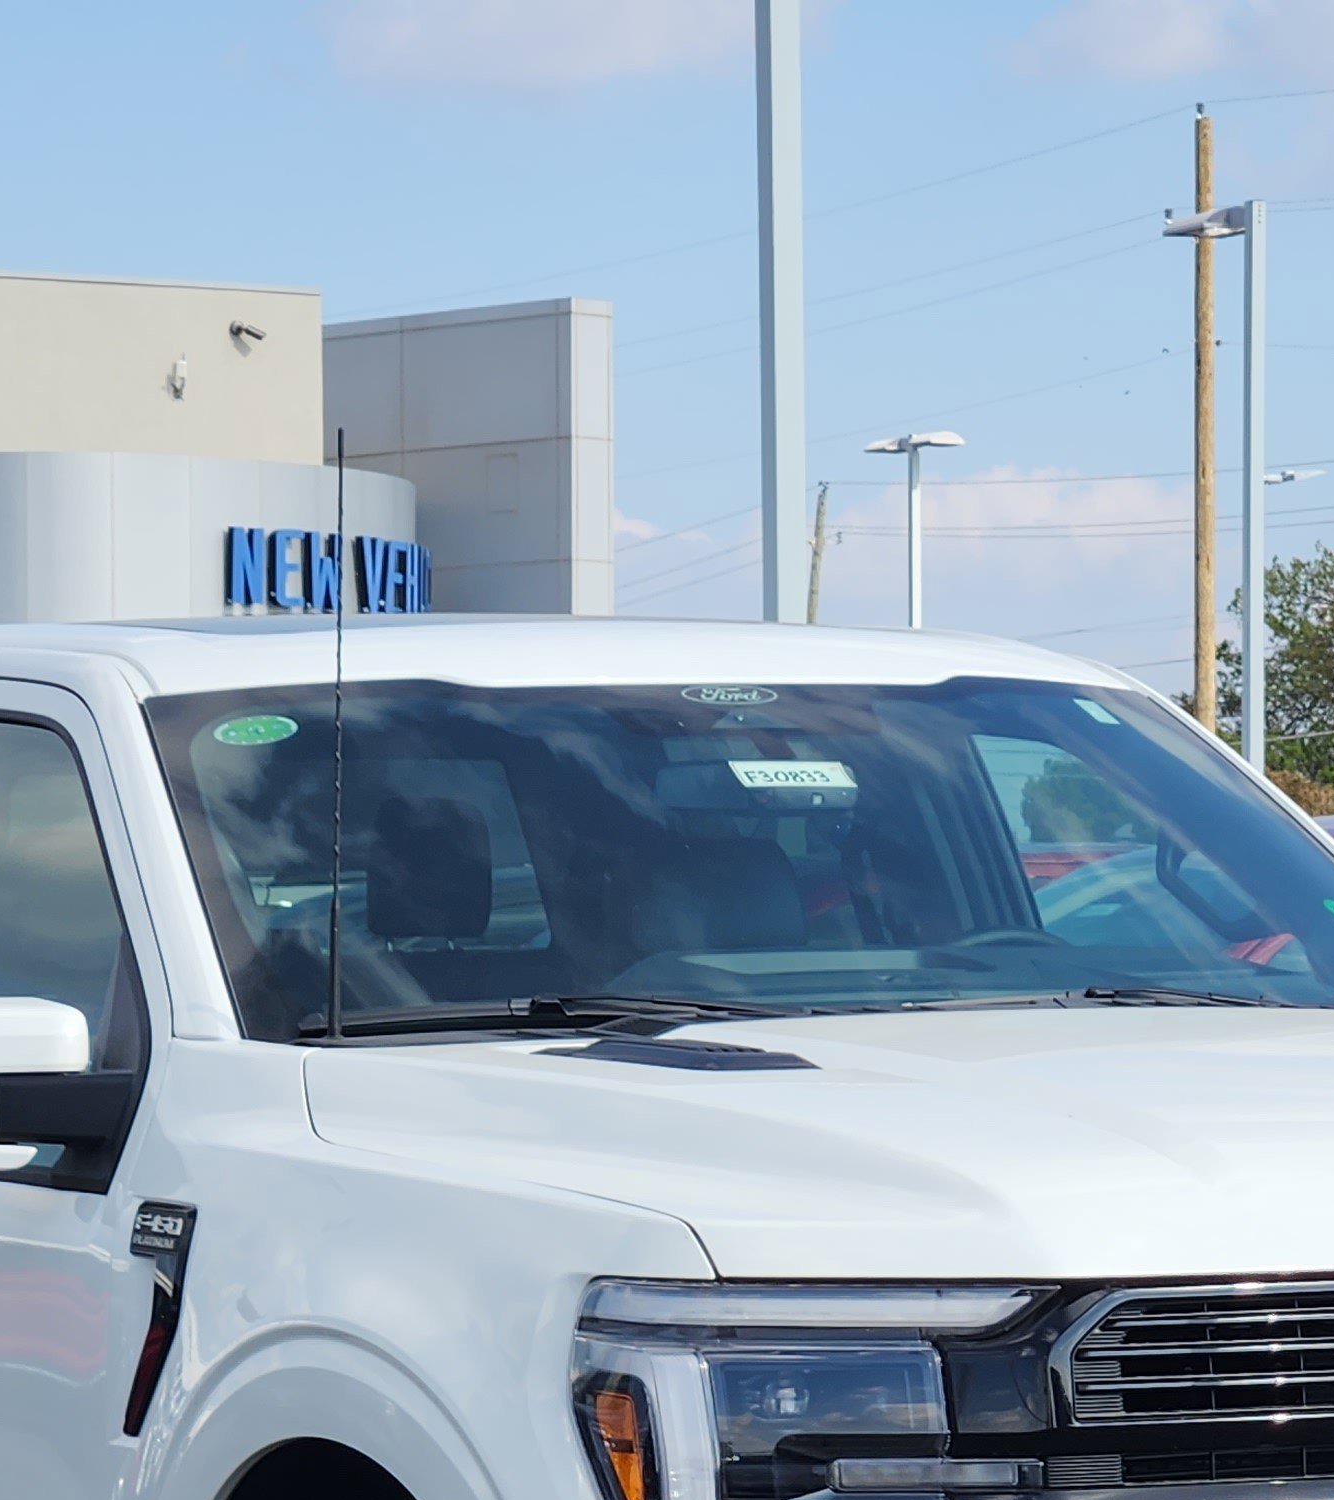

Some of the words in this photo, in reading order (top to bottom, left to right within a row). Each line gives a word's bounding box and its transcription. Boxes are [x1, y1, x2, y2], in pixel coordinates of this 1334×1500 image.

[229, 526, 340, 613] NEW
[699, 686, 762, 702] Ford
[744, 770, 831, 784] F30833
